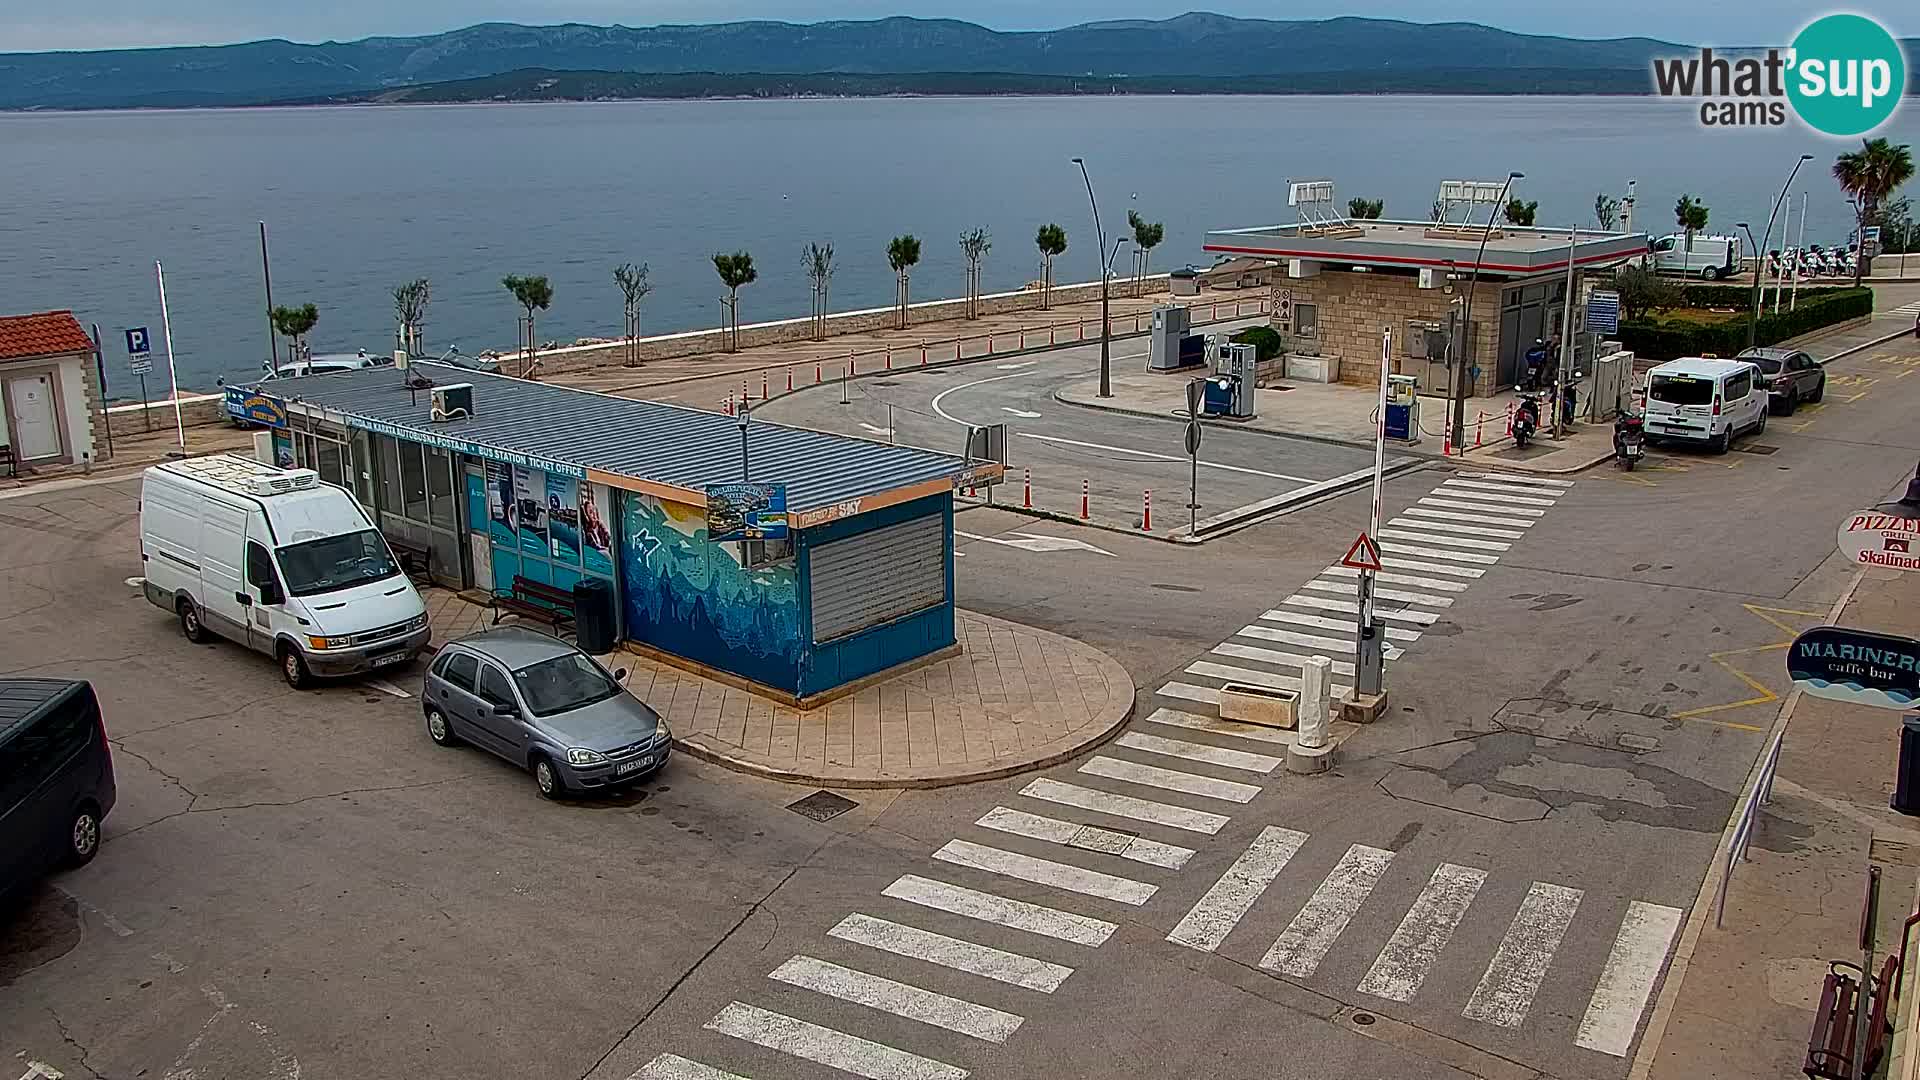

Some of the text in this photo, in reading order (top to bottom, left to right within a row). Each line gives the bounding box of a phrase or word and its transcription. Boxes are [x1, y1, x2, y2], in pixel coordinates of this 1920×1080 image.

[131, 331, 143, 350] P
[397, 427, 436, 445] AUTOBUSNA
[437, 438, 468, 452] POSTAJA
[478, 446, 493, 458] BUS
[495, 450, 527, 465] STATION
[529, 457, 554, 471] TICKET
[555, 463, 583, 476] OFFICE
[1848, 515, 1920, 534] PIZZE
[1881, 531, 1917, 541] GRILL
[1828, 663, 1896, 680] caffe bar
